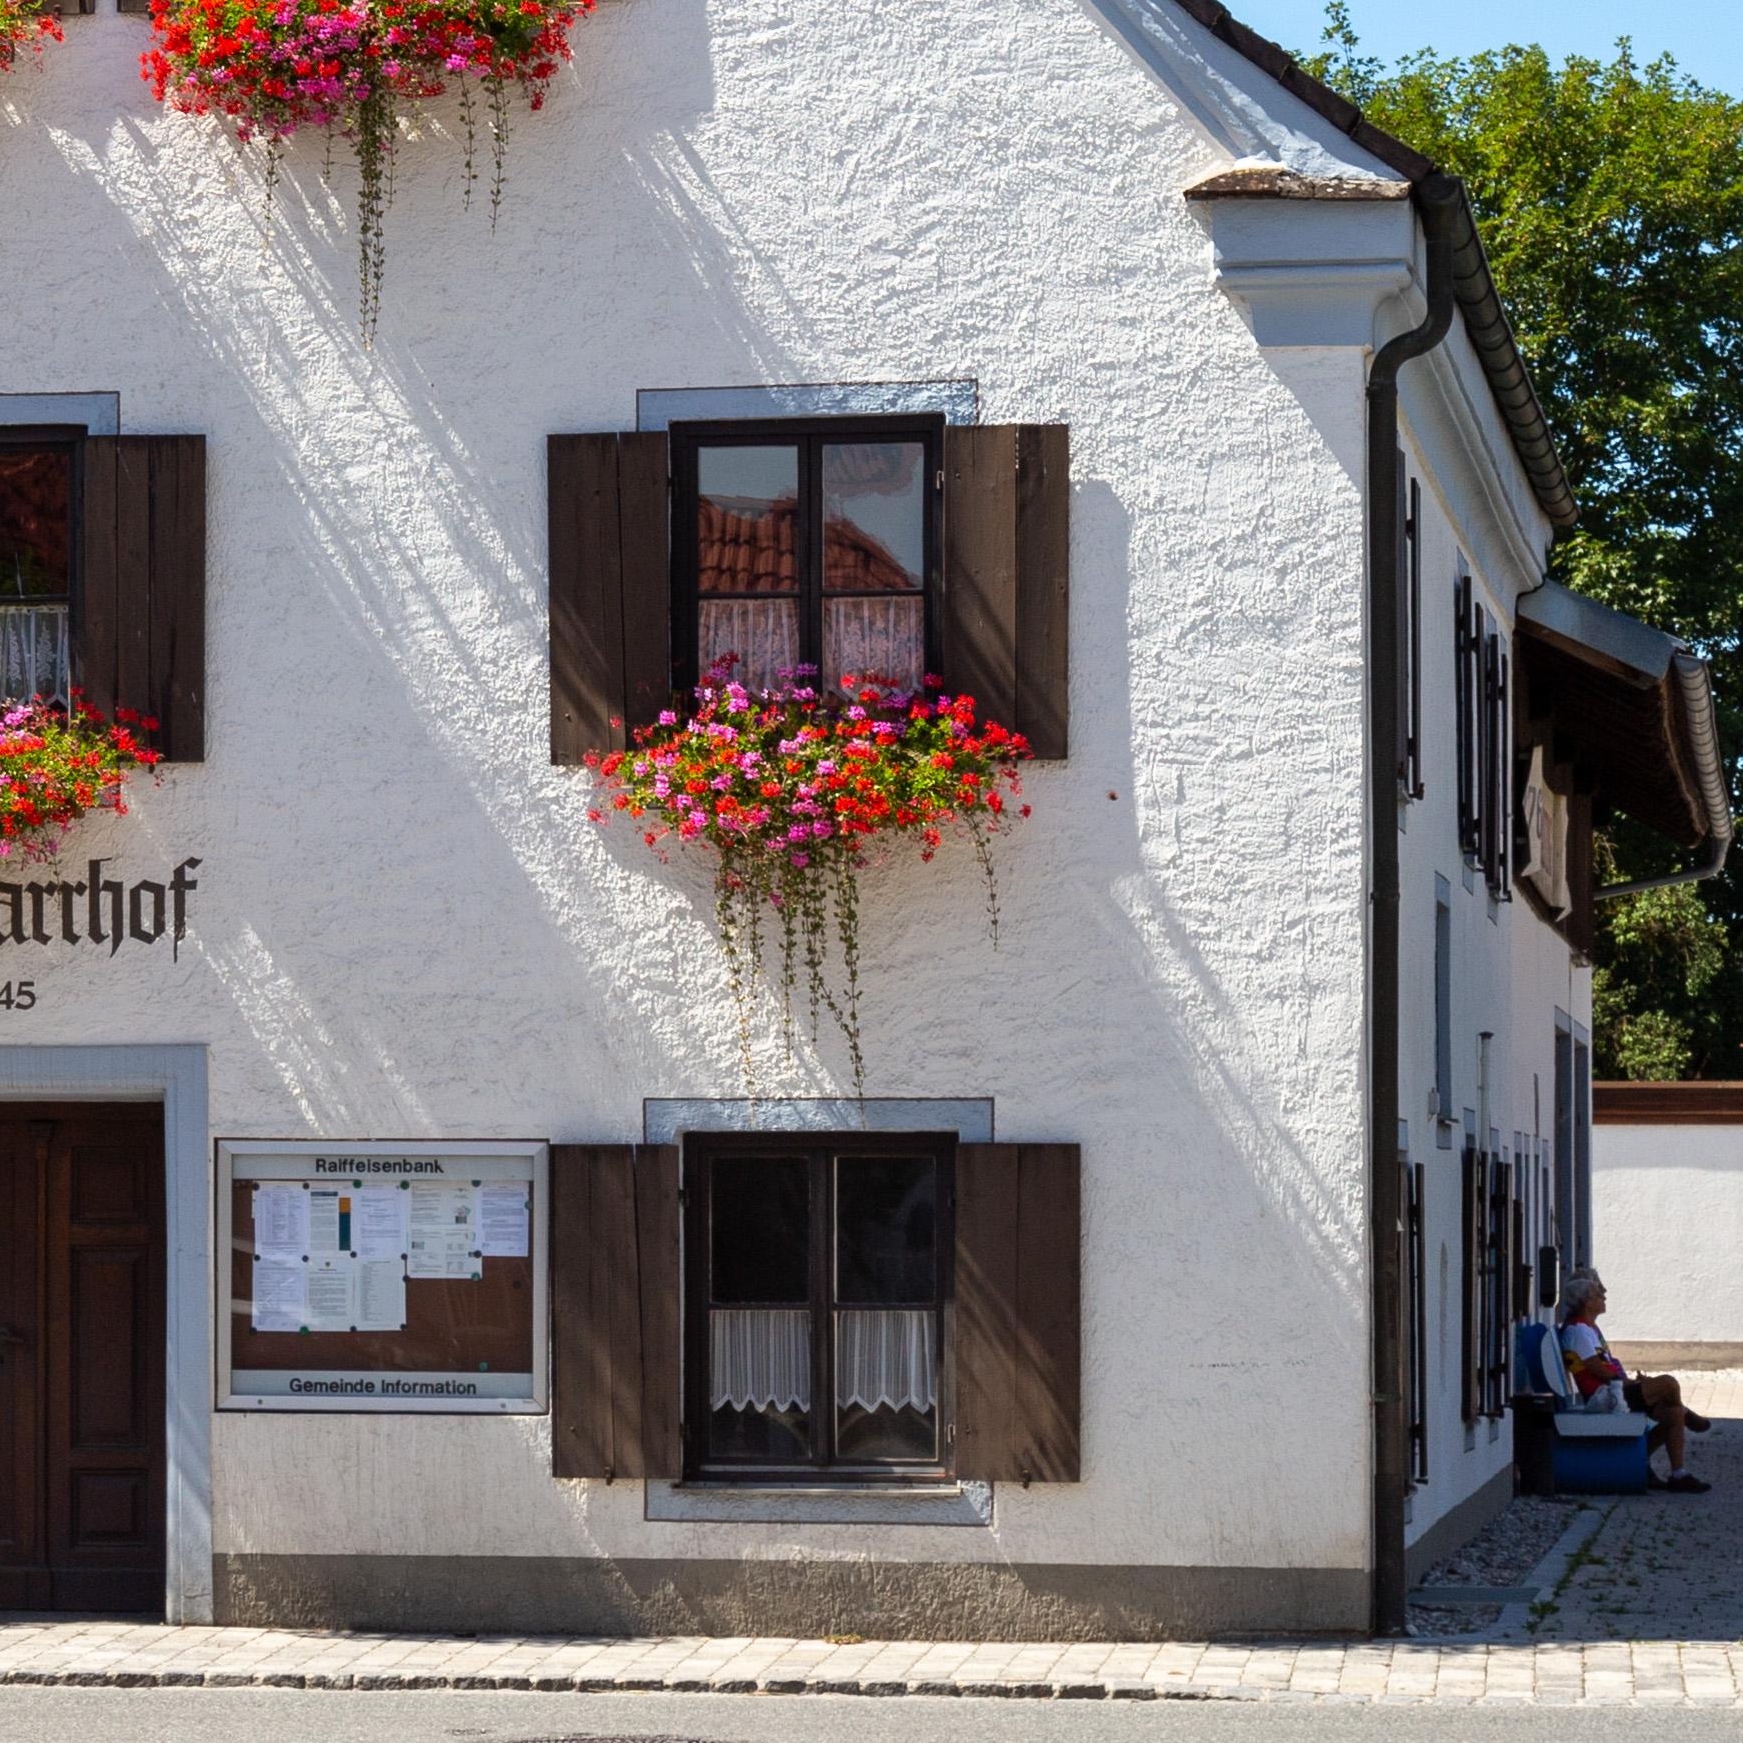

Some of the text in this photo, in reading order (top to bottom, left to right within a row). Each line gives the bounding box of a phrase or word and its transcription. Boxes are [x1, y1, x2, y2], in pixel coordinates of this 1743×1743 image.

[315, 1158, 444, 1174] Raiffeisenbank
[289, 1378, 477, 1396] Gemeinde Information
